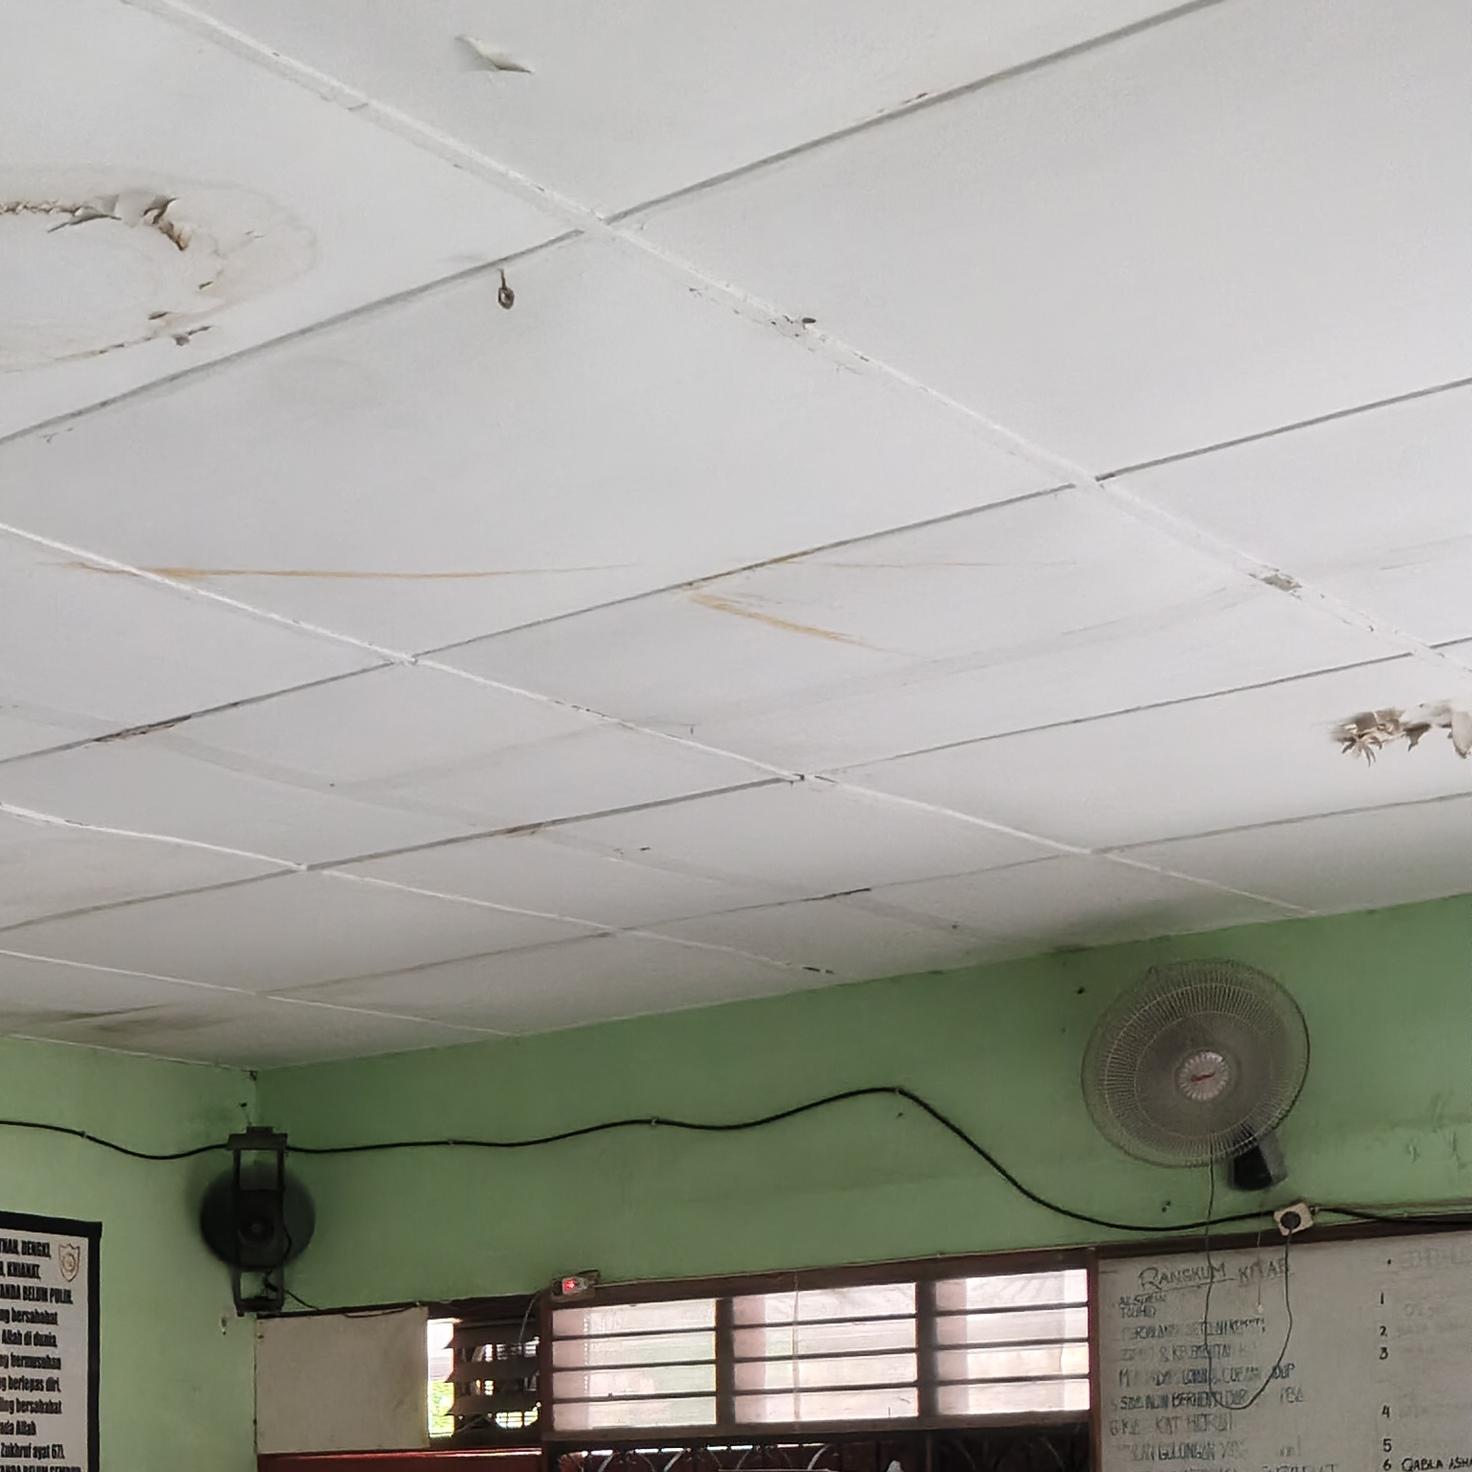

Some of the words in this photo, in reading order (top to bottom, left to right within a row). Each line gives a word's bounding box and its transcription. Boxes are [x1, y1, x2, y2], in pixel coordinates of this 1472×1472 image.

[1139, 1263, 1226, 1290] RANGKUM
[1382, 1405, 1390, 1418] 4
[1383, 1439, 1392, 1452] 5
[1383, 1459, 1391, 1471] 6
